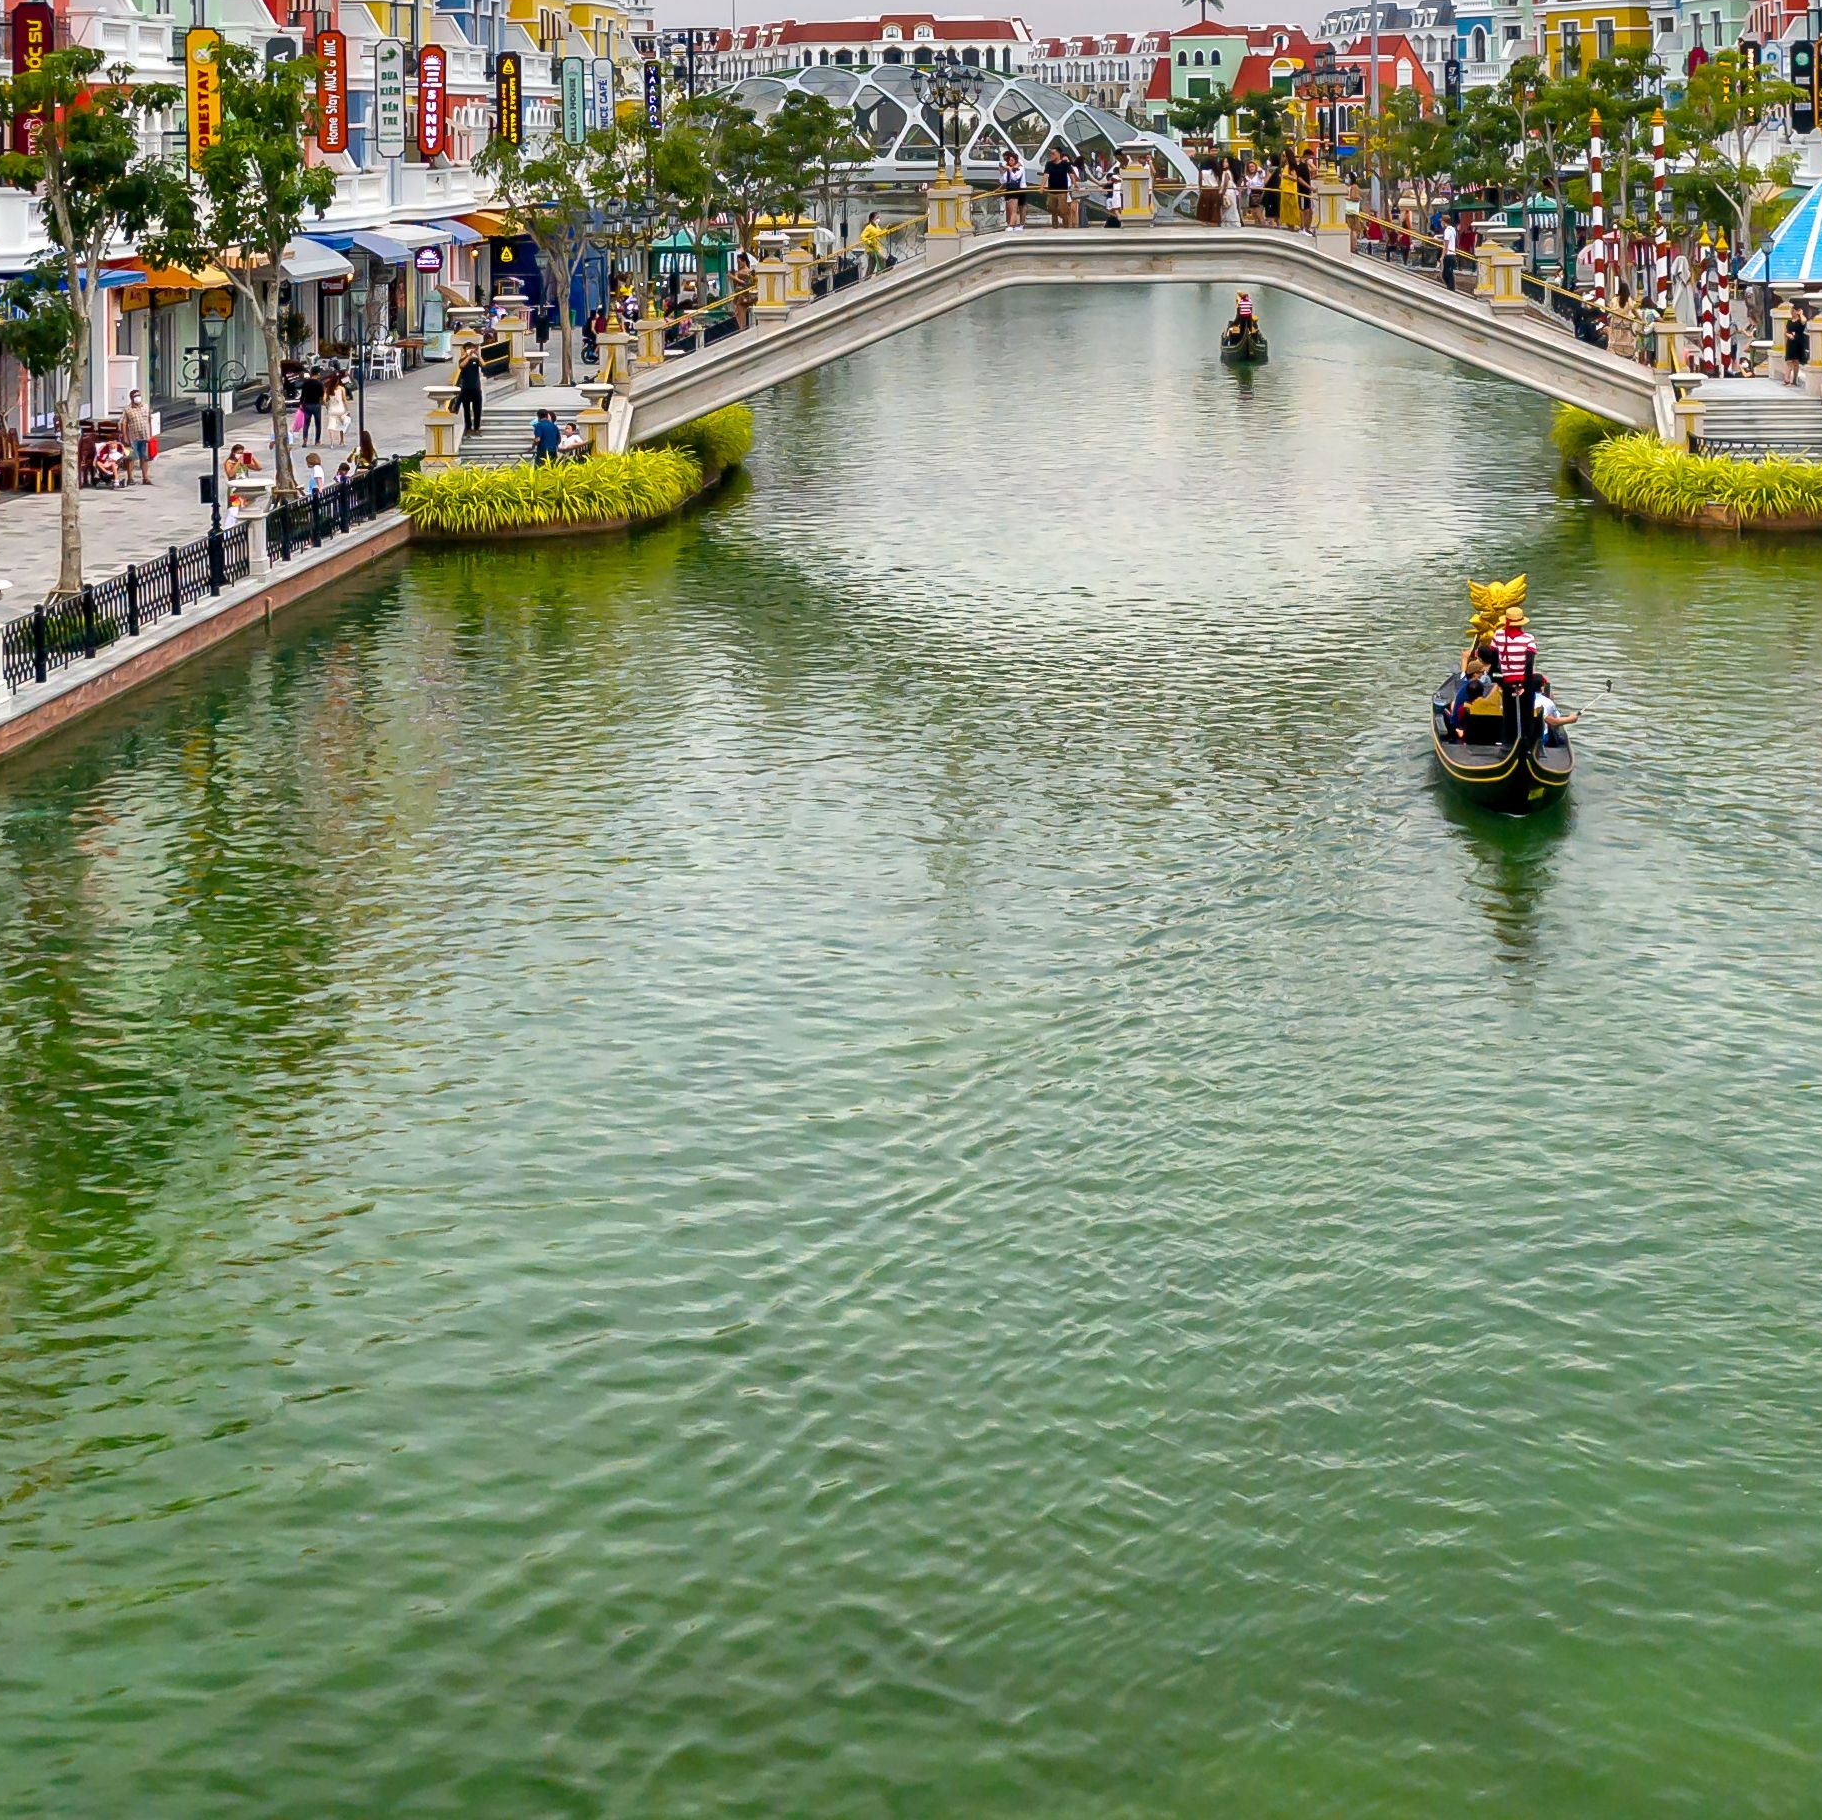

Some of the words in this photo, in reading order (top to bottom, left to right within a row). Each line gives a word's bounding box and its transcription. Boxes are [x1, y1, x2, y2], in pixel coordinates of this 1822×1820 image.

[198, 70, 211, 154] OMESTAY
[325, 94, 340, 115] Stay
[425, 89, 437, 149] SUNNY
[326, 118, 339, 145] Home
